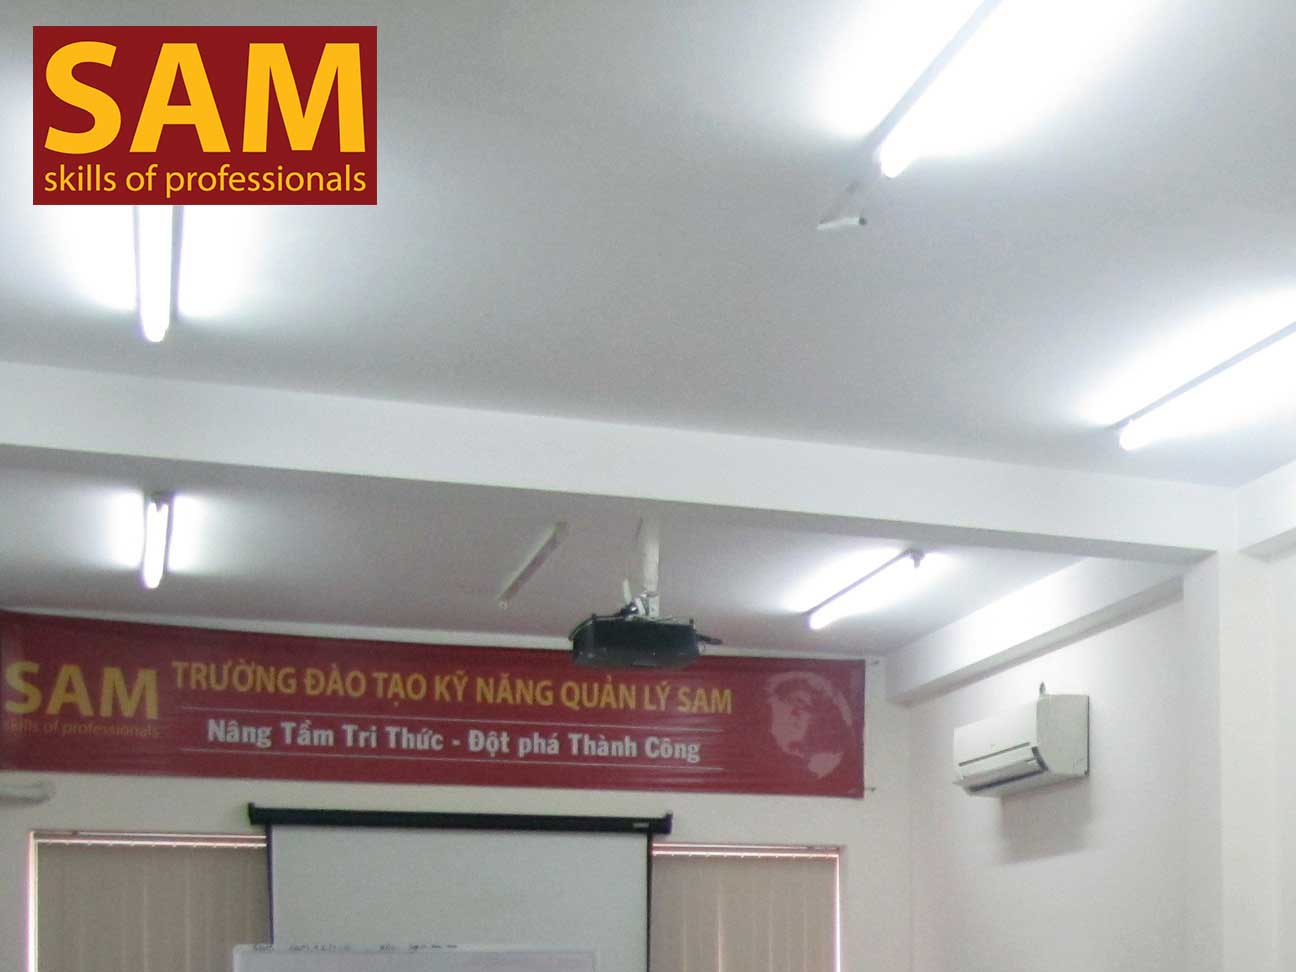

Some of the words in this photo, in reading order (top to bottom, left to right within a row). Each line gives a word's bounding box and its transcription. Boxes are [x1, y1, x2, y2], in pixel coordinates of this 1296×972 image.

[5, 661, 160, 720] SAM
[171, 659, 297, 696] TRƯỜNG
[304, 663, 366, 697] ĐÀO
[374, 673, 427, 707] TẠO
[433, 669, 469, 701] KỸ
[475, 675, 554, 707] NĂNG
[560, 673, 637, 711] QUẢN
[643, 678, 671, 711] LÝ
[678, 687, 733, 715] SAM
[207, 718, 272, 749] Nâng
[281, 720, 334, 748] Tầm
[385, 725, 444, 751] Thức
[468, 729, 509, 758] Đột
[518, 731, 560, 757] phá
[568, 733, 638, 759] Thành
[644, 736, 700, 763] Công
